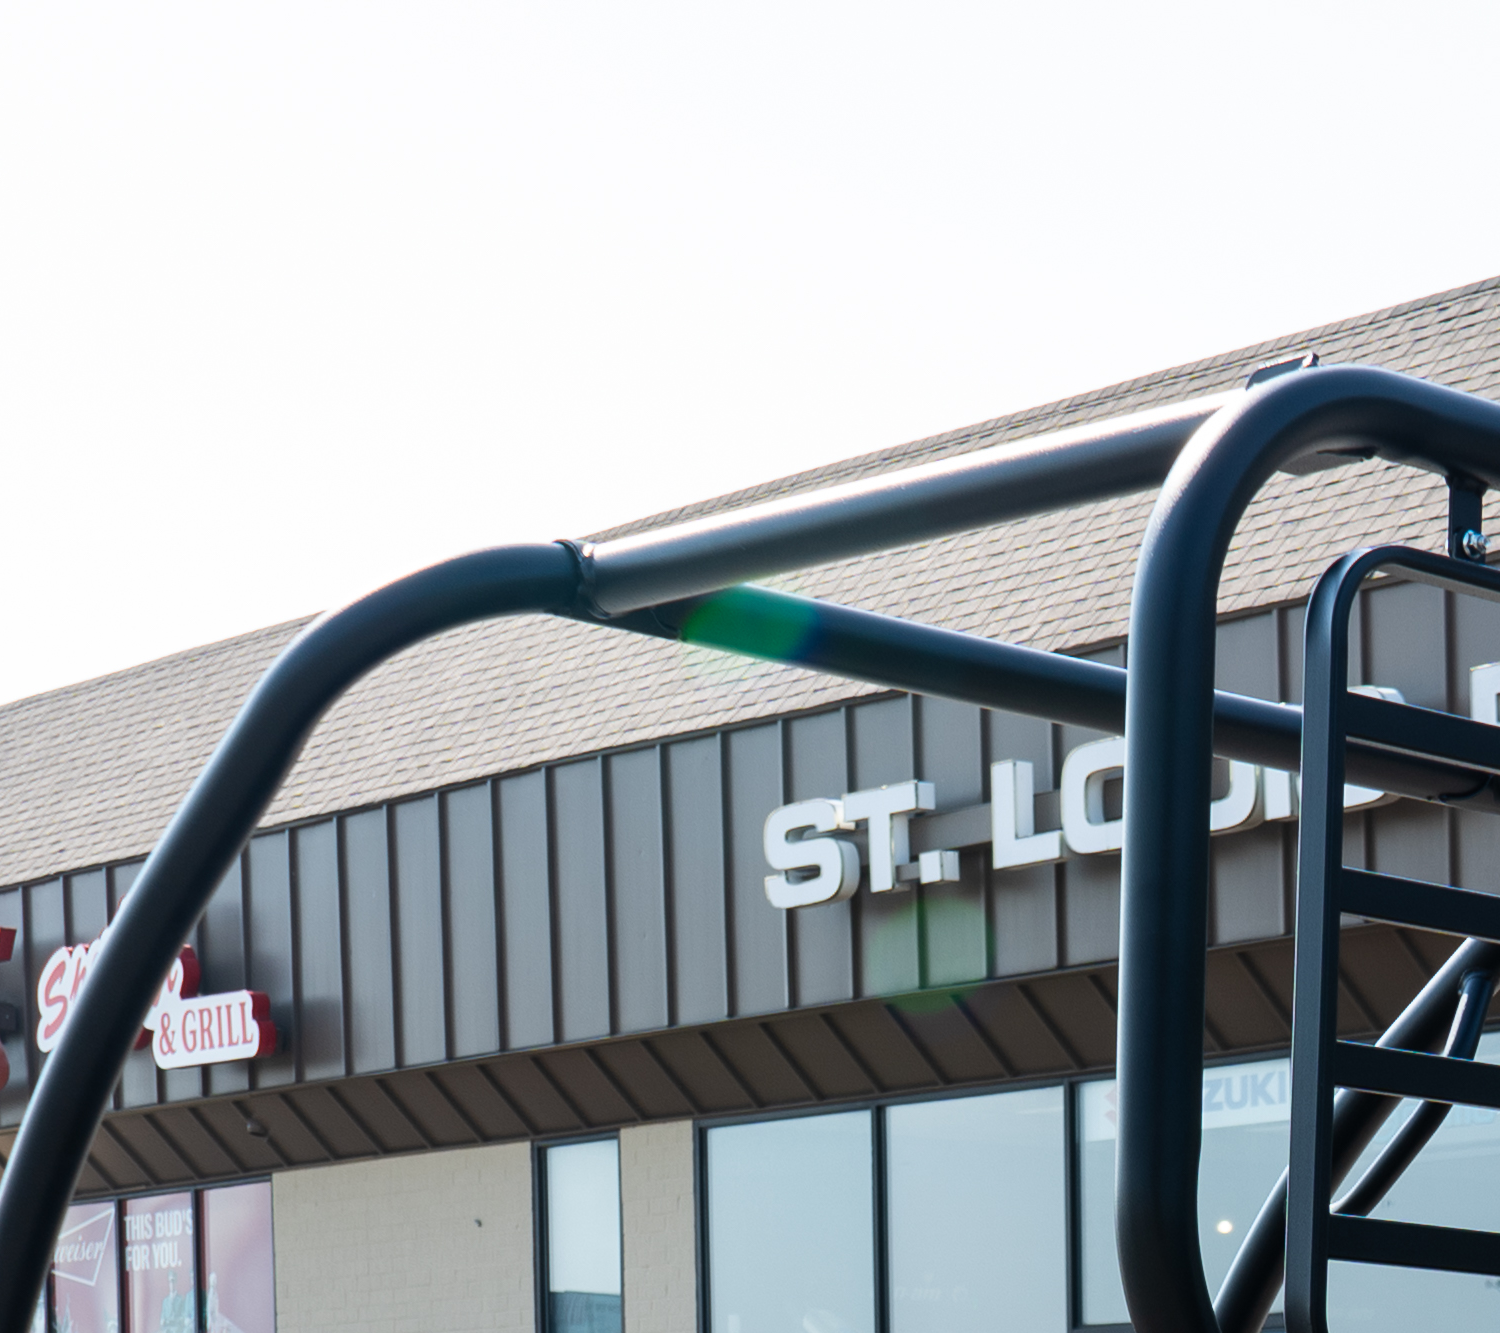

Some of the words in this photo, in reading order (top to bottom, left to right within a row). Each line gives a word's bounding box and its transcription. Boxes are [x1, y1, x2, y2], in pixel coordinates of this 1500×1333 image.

[762, 780, 960, 909] ST.
[159, 1012, 177, 1056] &
[182, 1001, 254, 1053] GRILL
[1201, 1071, 1288, 1112] ZUKI
[124, 1213, 153, 1242] THIS
[155, 1209, 194, 1238] BUD'S
[53, 1234, 104, 1264] weiser
[125, 1244, 150, 1272] FOR
[152, 1241, 182, 1269] YOU.
